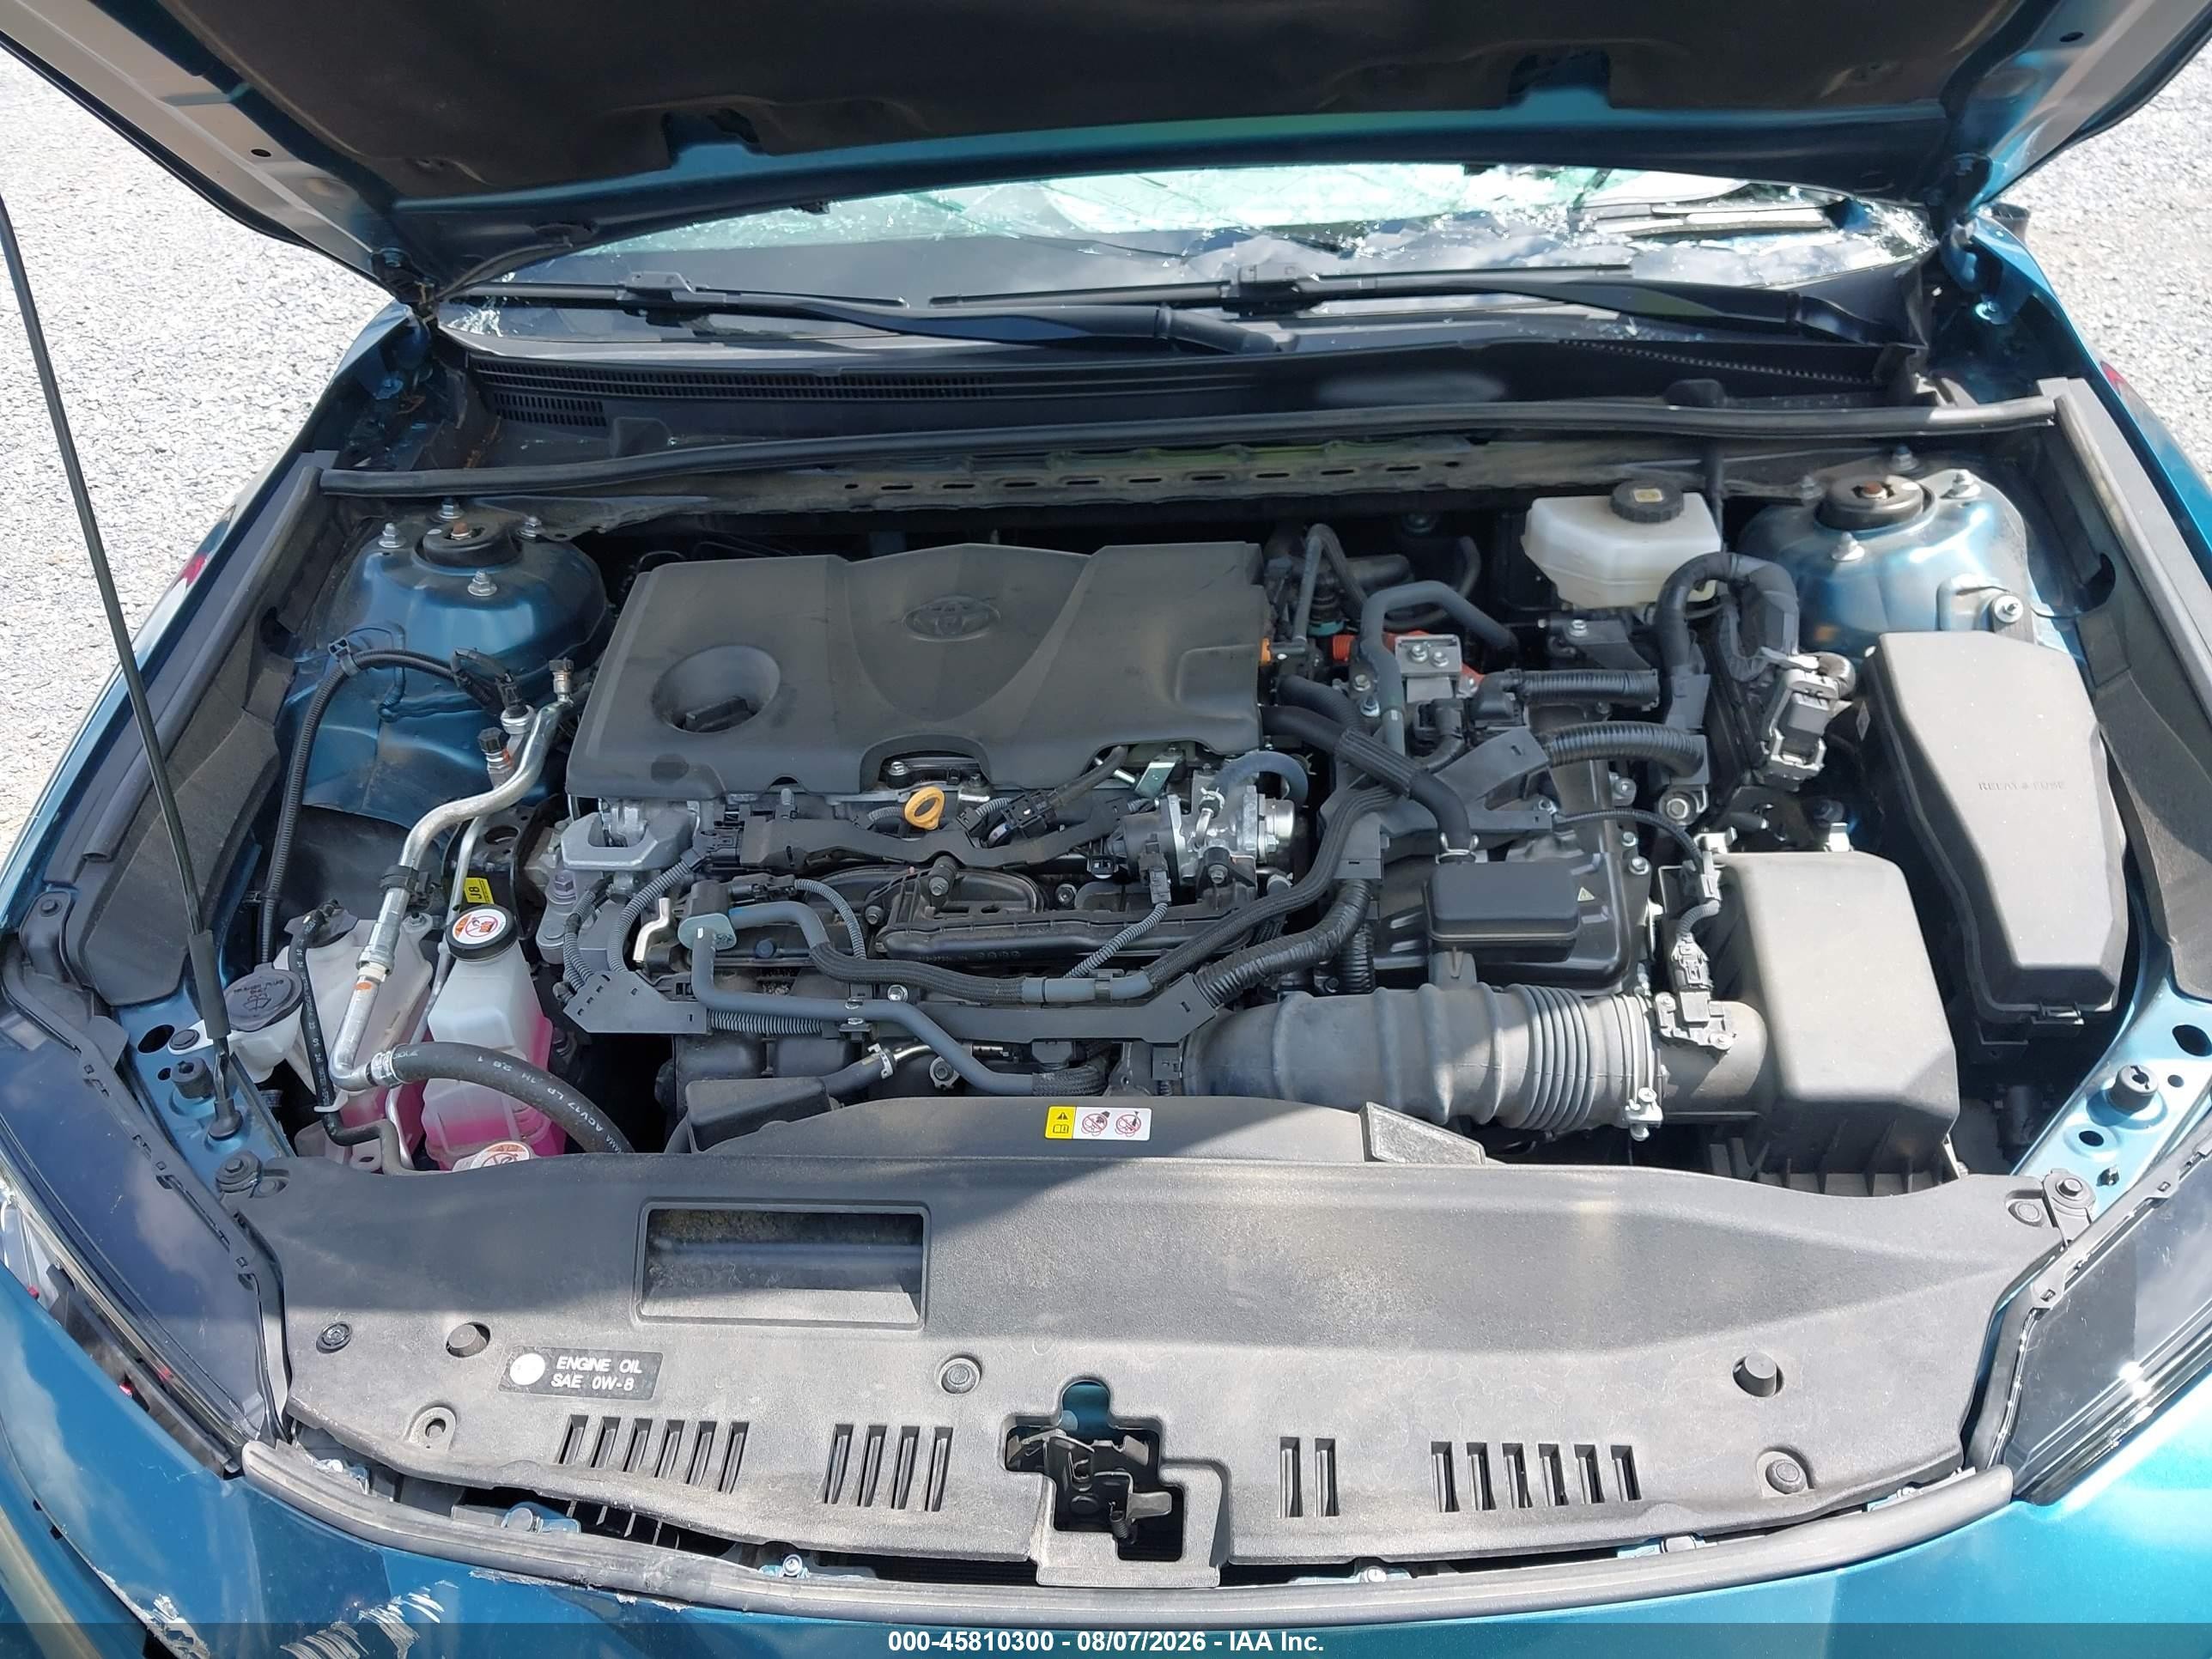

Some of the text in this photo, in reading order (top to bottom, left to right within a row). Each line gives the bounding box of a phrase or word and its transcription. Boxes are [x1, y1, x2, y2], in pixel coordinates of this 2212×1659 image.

[468, 886, 483, 900] J8
[547, 1087, 564, 1100] LP
[568, 1102, 604, 1132] ACV17
[556, 1356, 643, 1374] ENGINE OIL
[550, 1374, 635, 1391] SAE 0W-8
